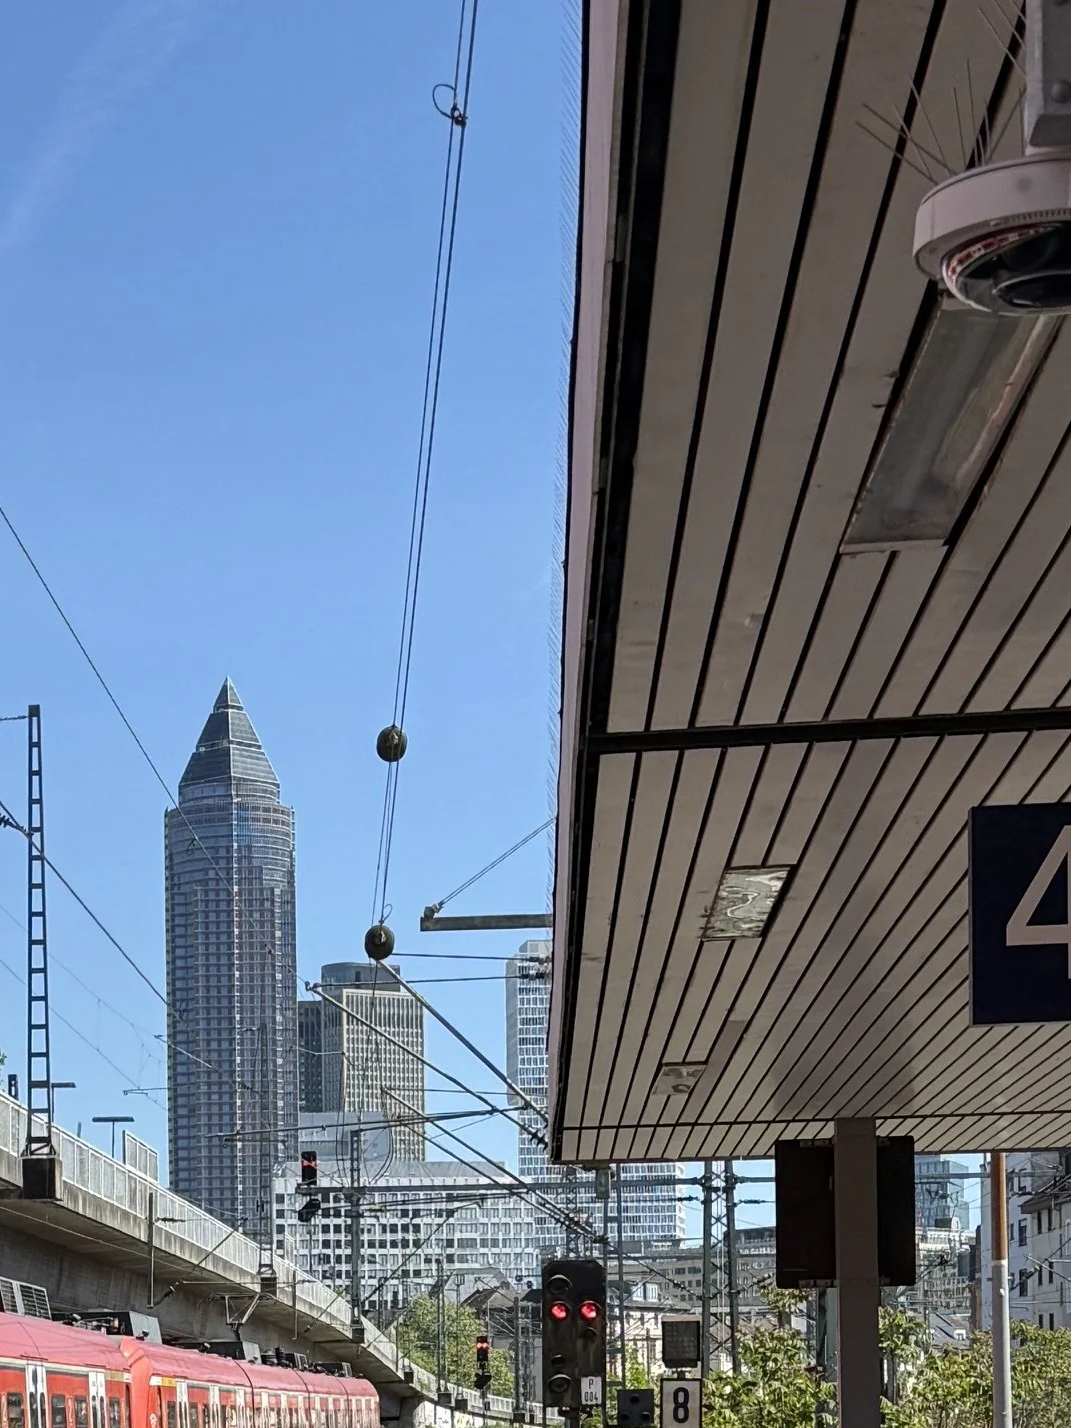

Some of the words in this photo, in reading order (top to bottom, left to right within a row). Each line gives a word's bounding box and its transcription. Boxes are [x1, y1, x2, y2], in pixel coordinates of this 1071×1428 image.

[1006, 824, 1071, 980] 4
[588, 1378, 594, 1389] P
[673, 1387, 690, 1424] 8
